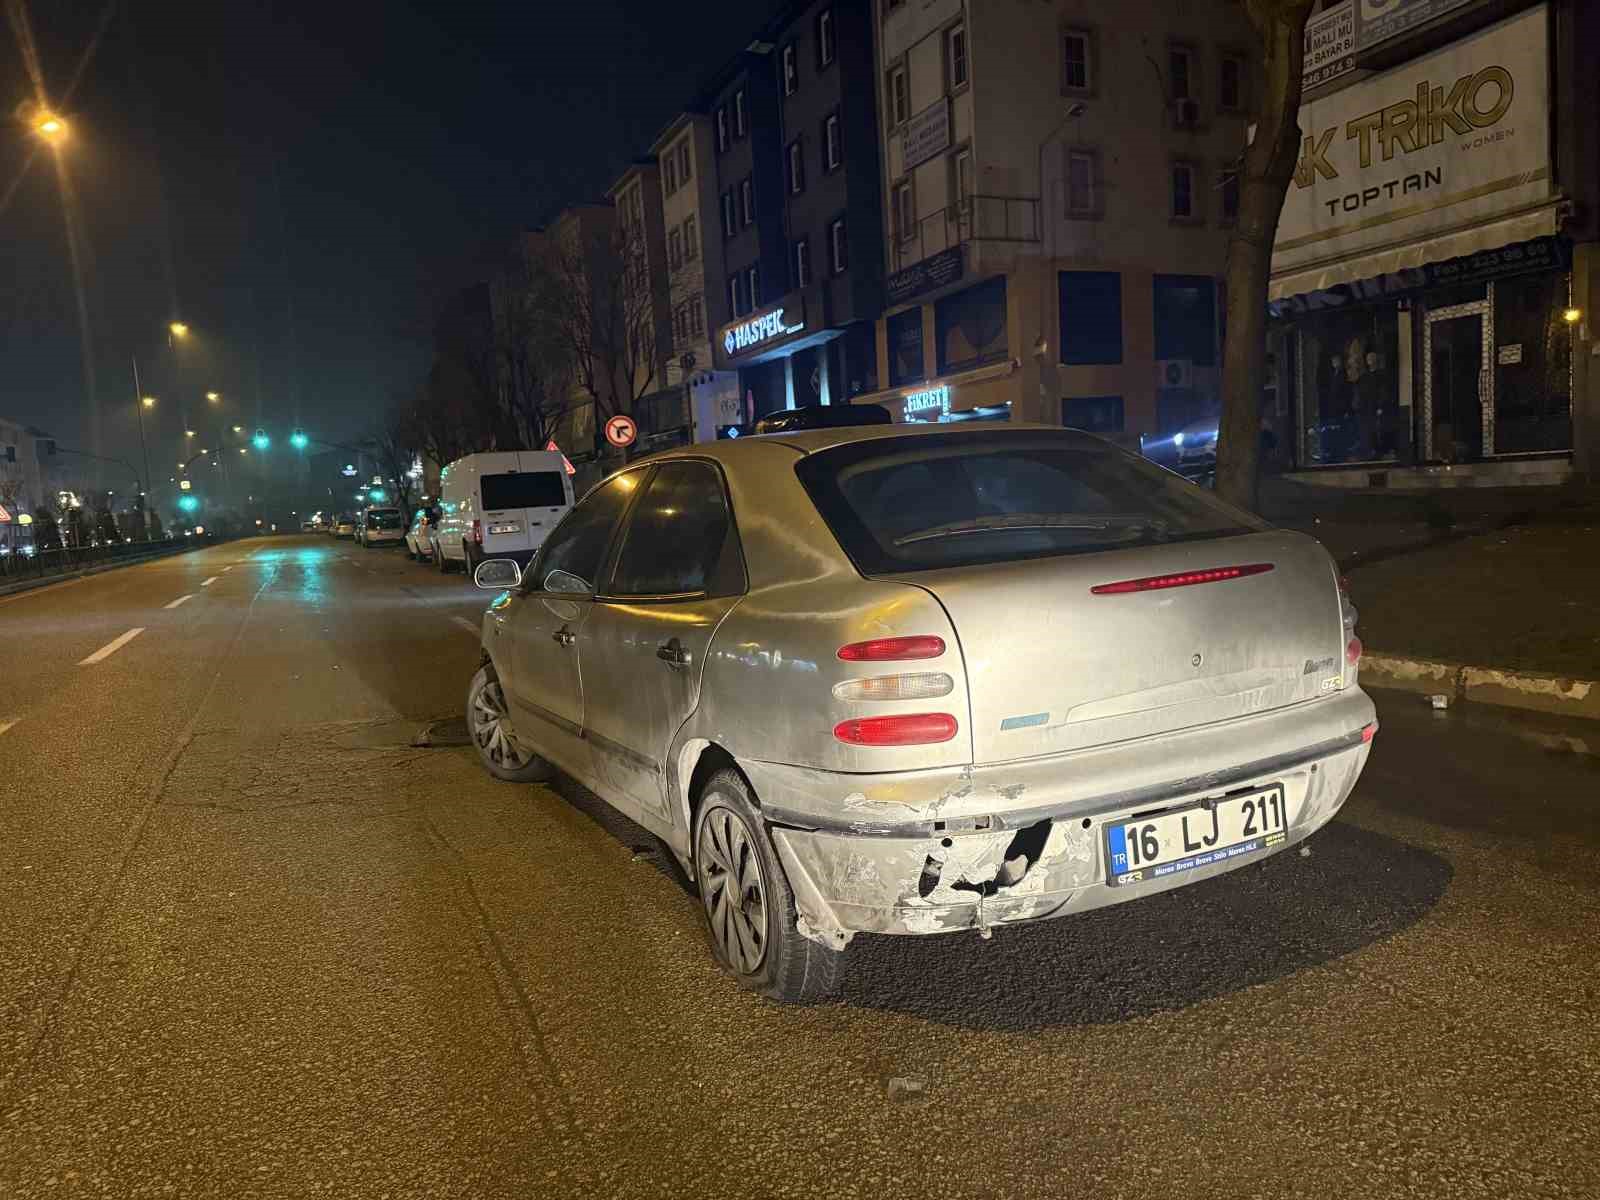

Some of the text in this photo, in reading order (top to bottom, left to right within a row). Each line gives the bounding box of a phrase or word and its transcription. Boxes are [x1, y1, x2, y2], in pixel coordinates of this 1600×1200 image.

[1460, 127, 1515, 152] WOMEN
[1325, 166, 1442, 217] TOPTAN
[735, 308, 785, 349] HASPEK
[1127, 792, 1280, 866] 16 LJ 211
[1113, 852, 1127, 865] TR
